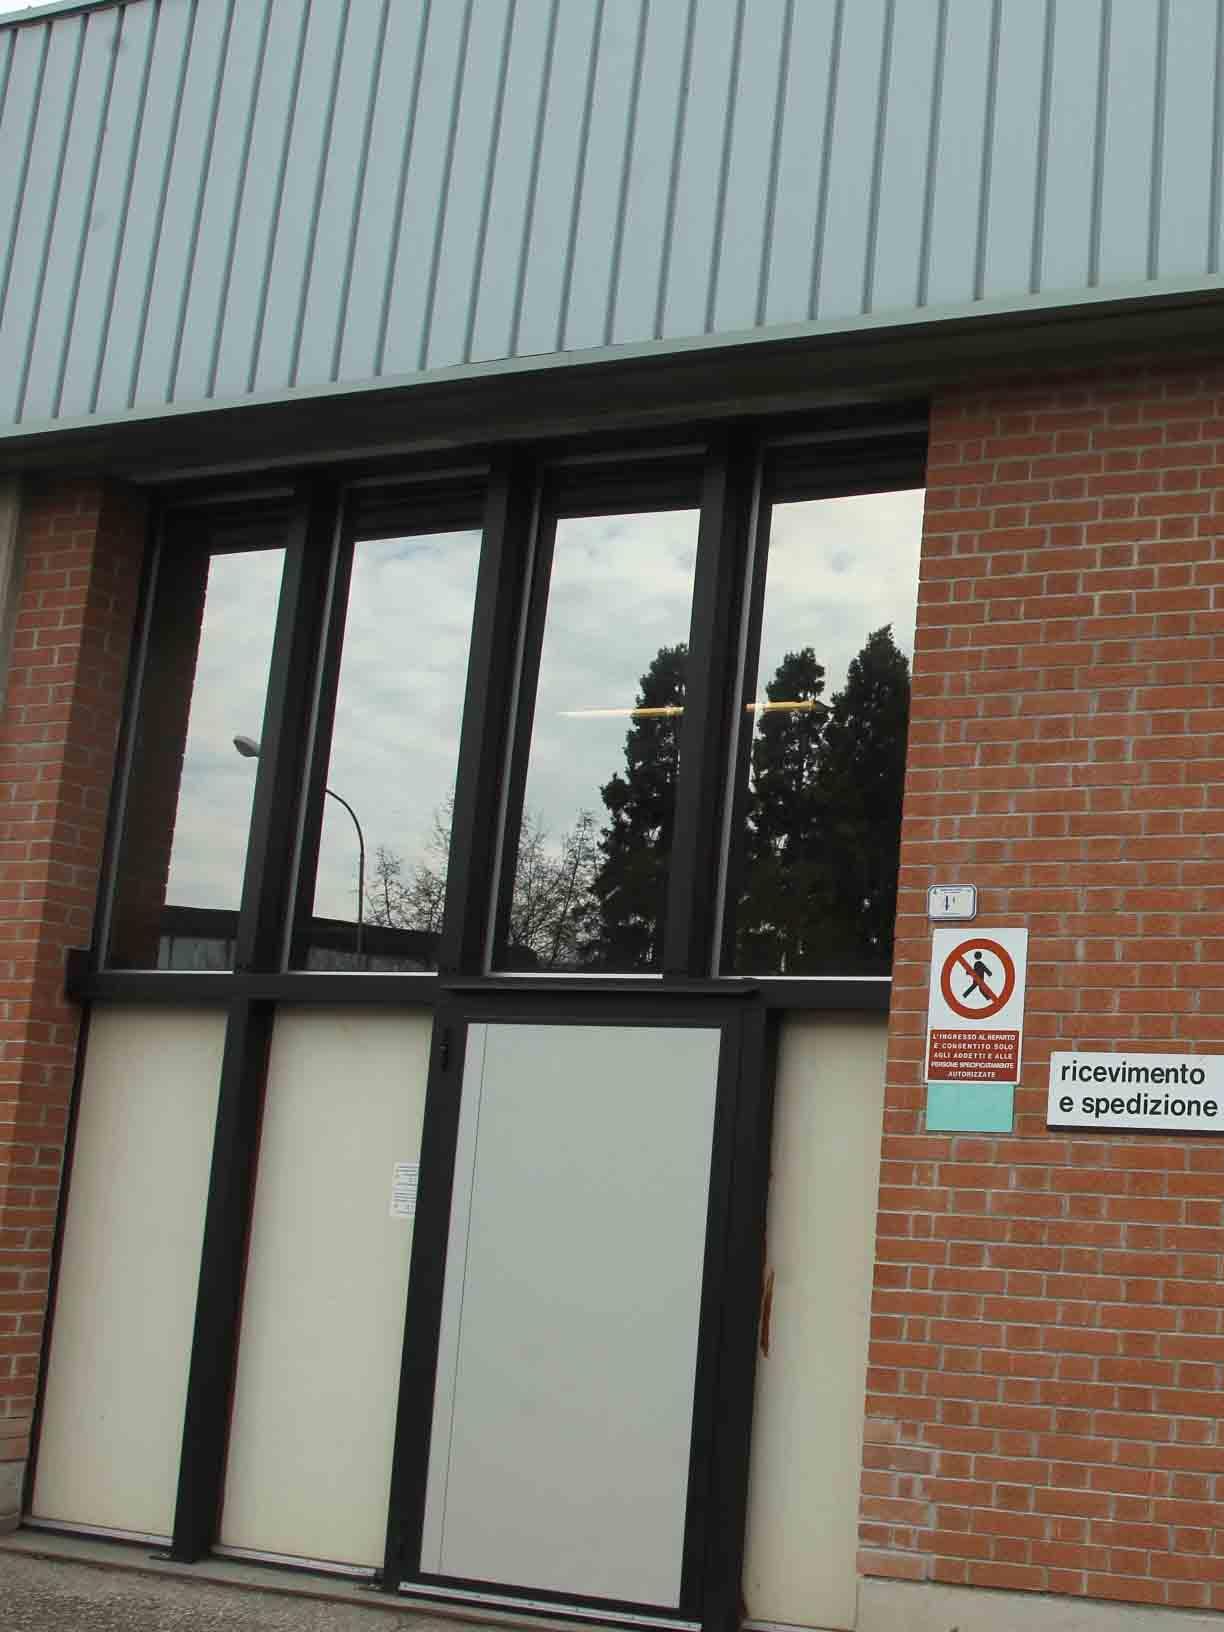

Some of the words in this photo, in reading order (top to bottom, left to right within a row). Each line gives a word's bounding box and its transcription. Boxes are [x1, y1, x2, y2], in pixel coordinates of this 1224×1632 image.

[953, 1052, 986, 1060] ADDETTI
[1061, 1060, 1205, 1085] ricevimento
[1058, 1096, 1074, 1113] e
[1081, 1093, 1219, 1119] spedizione
